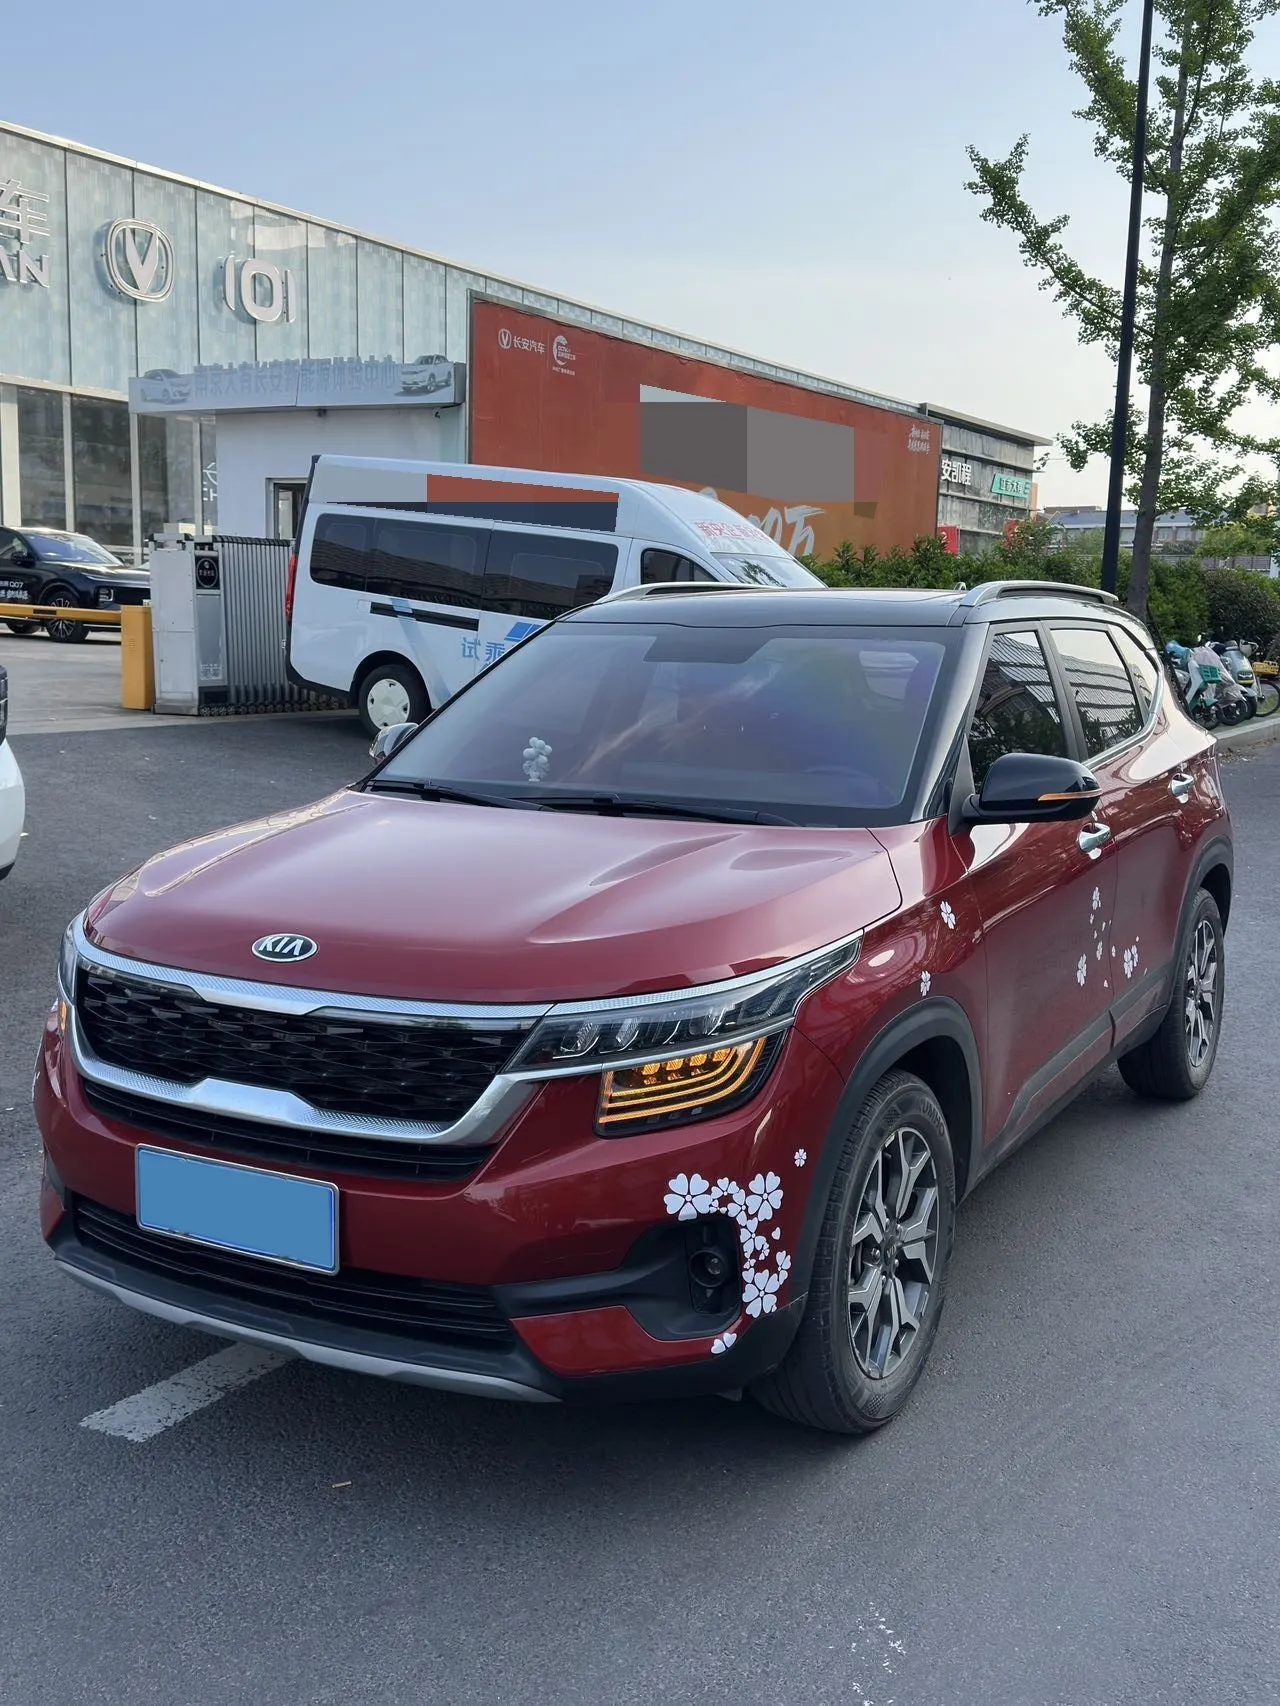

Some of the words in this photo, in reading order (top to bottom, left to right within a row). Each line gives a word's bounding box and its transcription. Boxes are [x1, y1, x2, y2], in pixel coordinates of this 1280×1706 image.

[513, 336, 546, 354] 长安汽车
[259, 936, 304, 956] KIA
